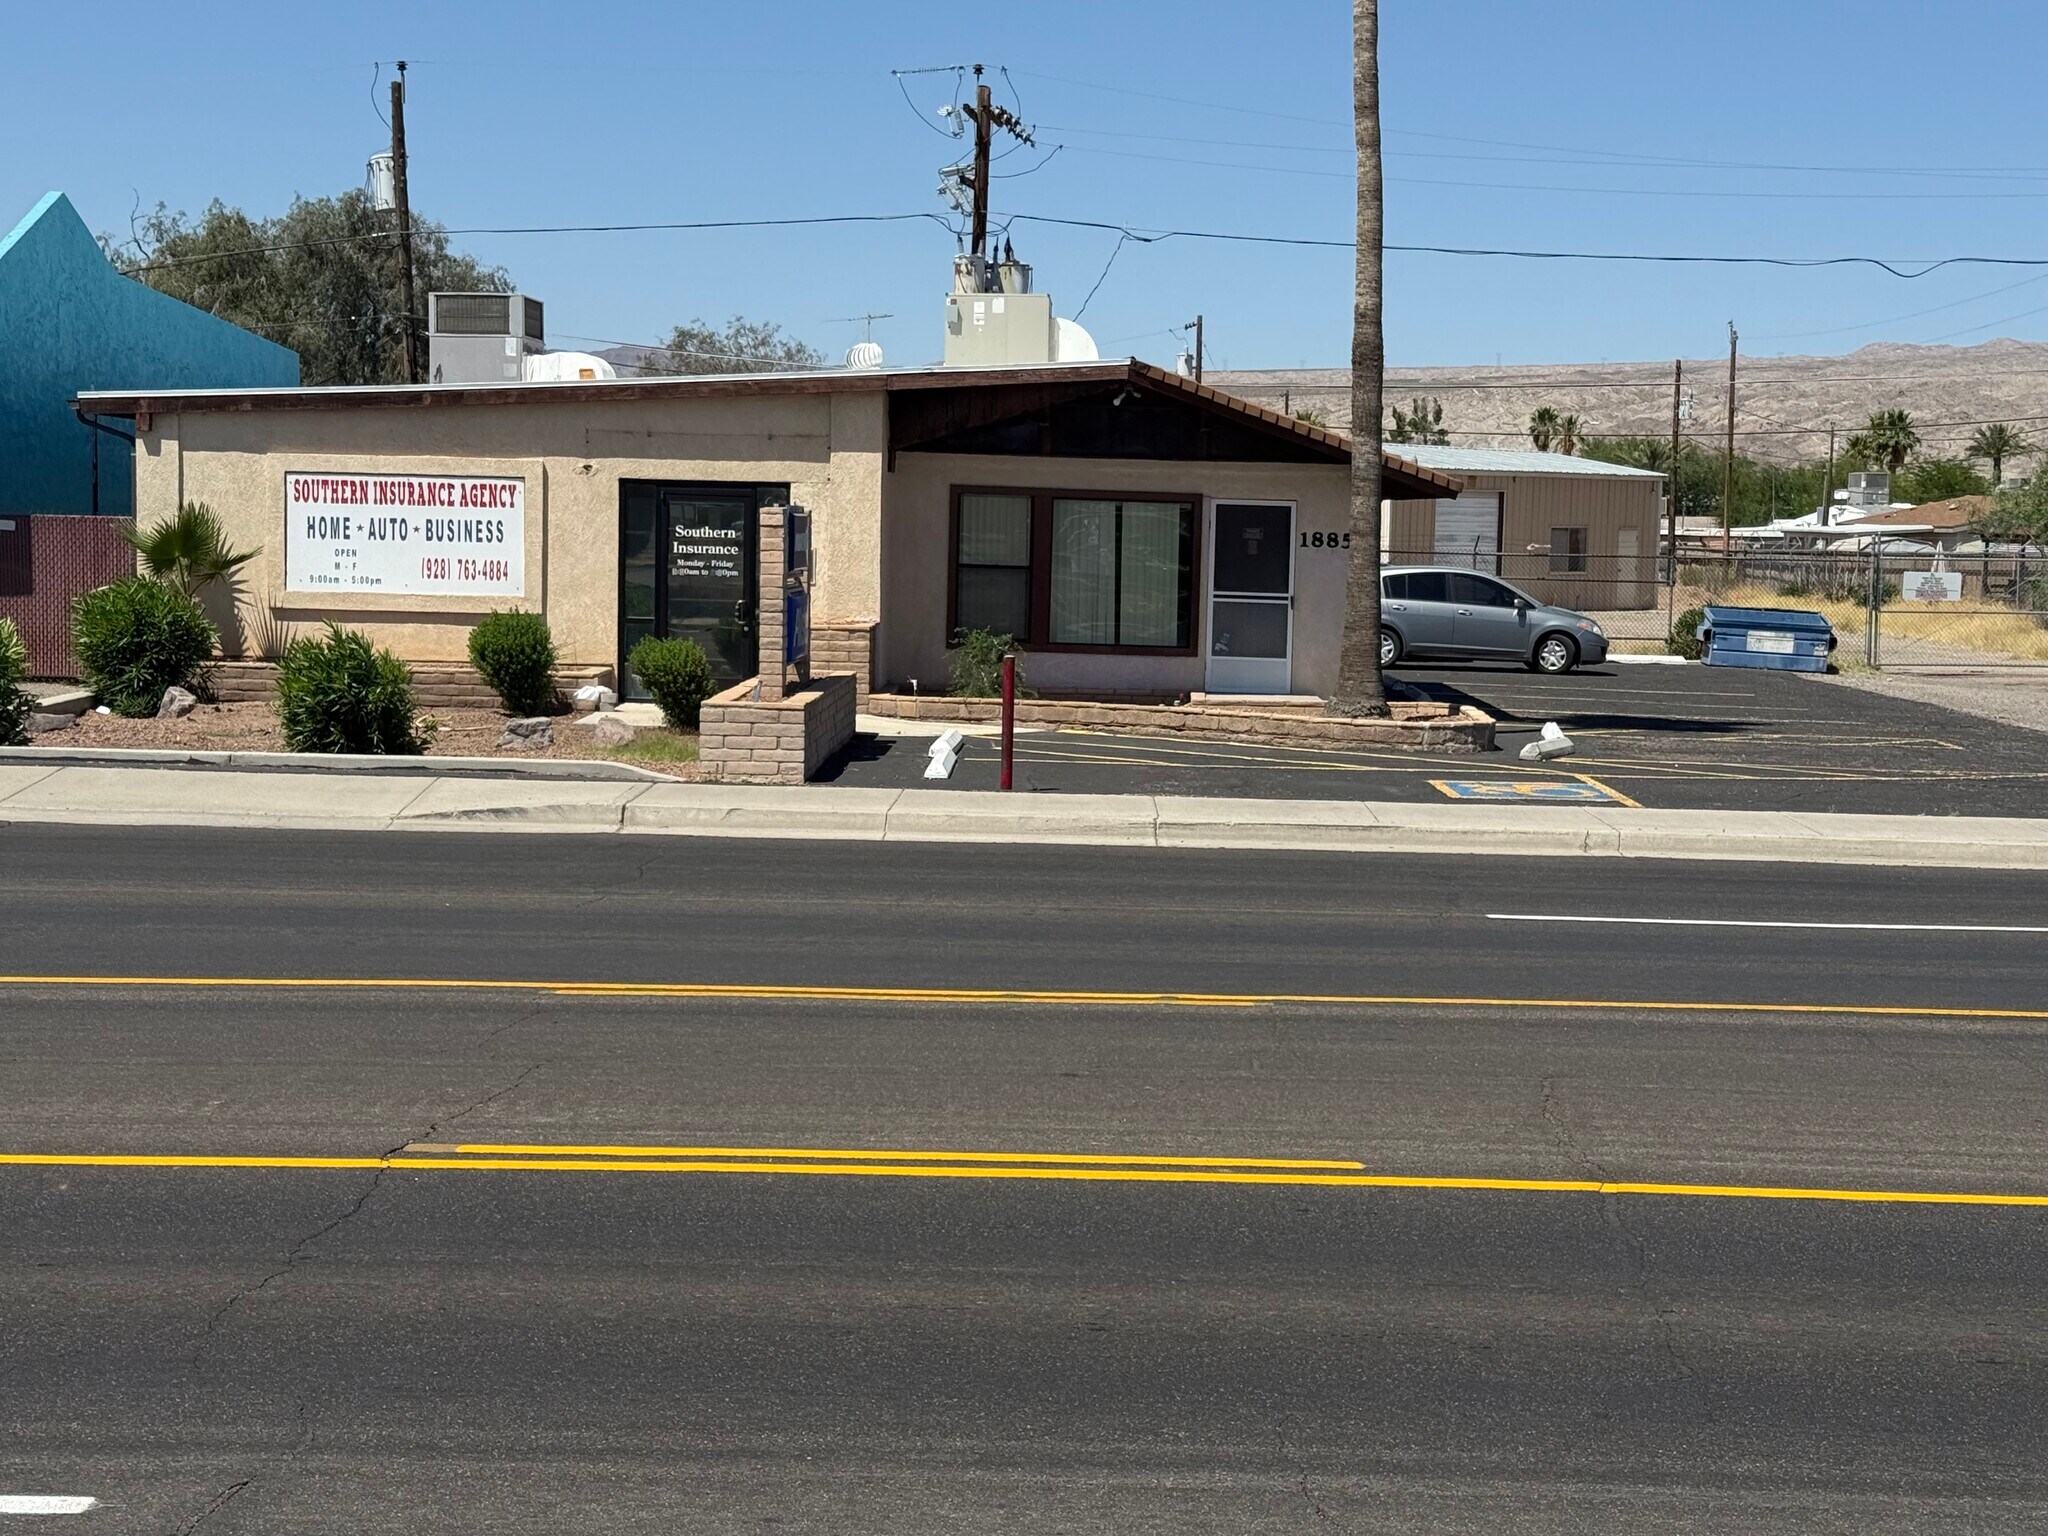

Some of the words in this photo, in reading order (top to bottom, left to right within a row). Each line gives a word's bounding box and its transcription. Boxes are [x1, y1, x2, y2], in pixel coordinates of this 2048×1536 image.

[293, 478, 369, 504] SOUTHERN
[373, 480, 456, 507] INSURANCE
[459, 483, 517, 508] AGENCY
[307, 516, 351, 540] HOME
[368, 517, 408, 541] AUTO
[425, 519, 504, 543] BUSINESS
[675, 525, 736, 538] Southern
[1300, 532, 1350, 549] 1885
[334, 548, 357, 558] OPEN
[673, 541, 739, 555] Insurance
[334, 562, 341, 571] M
[352, 562, 357, 571] F
[421, 557, 451, 580] (928)
[457, 558, 509, 582] 763-4884
[677, 559, 705, 568] Monday
[711, 560, 735, 569] Friday
[309, 574, 340, 584] 9:00am
[351, 575, 382, 586] 5:00pm
